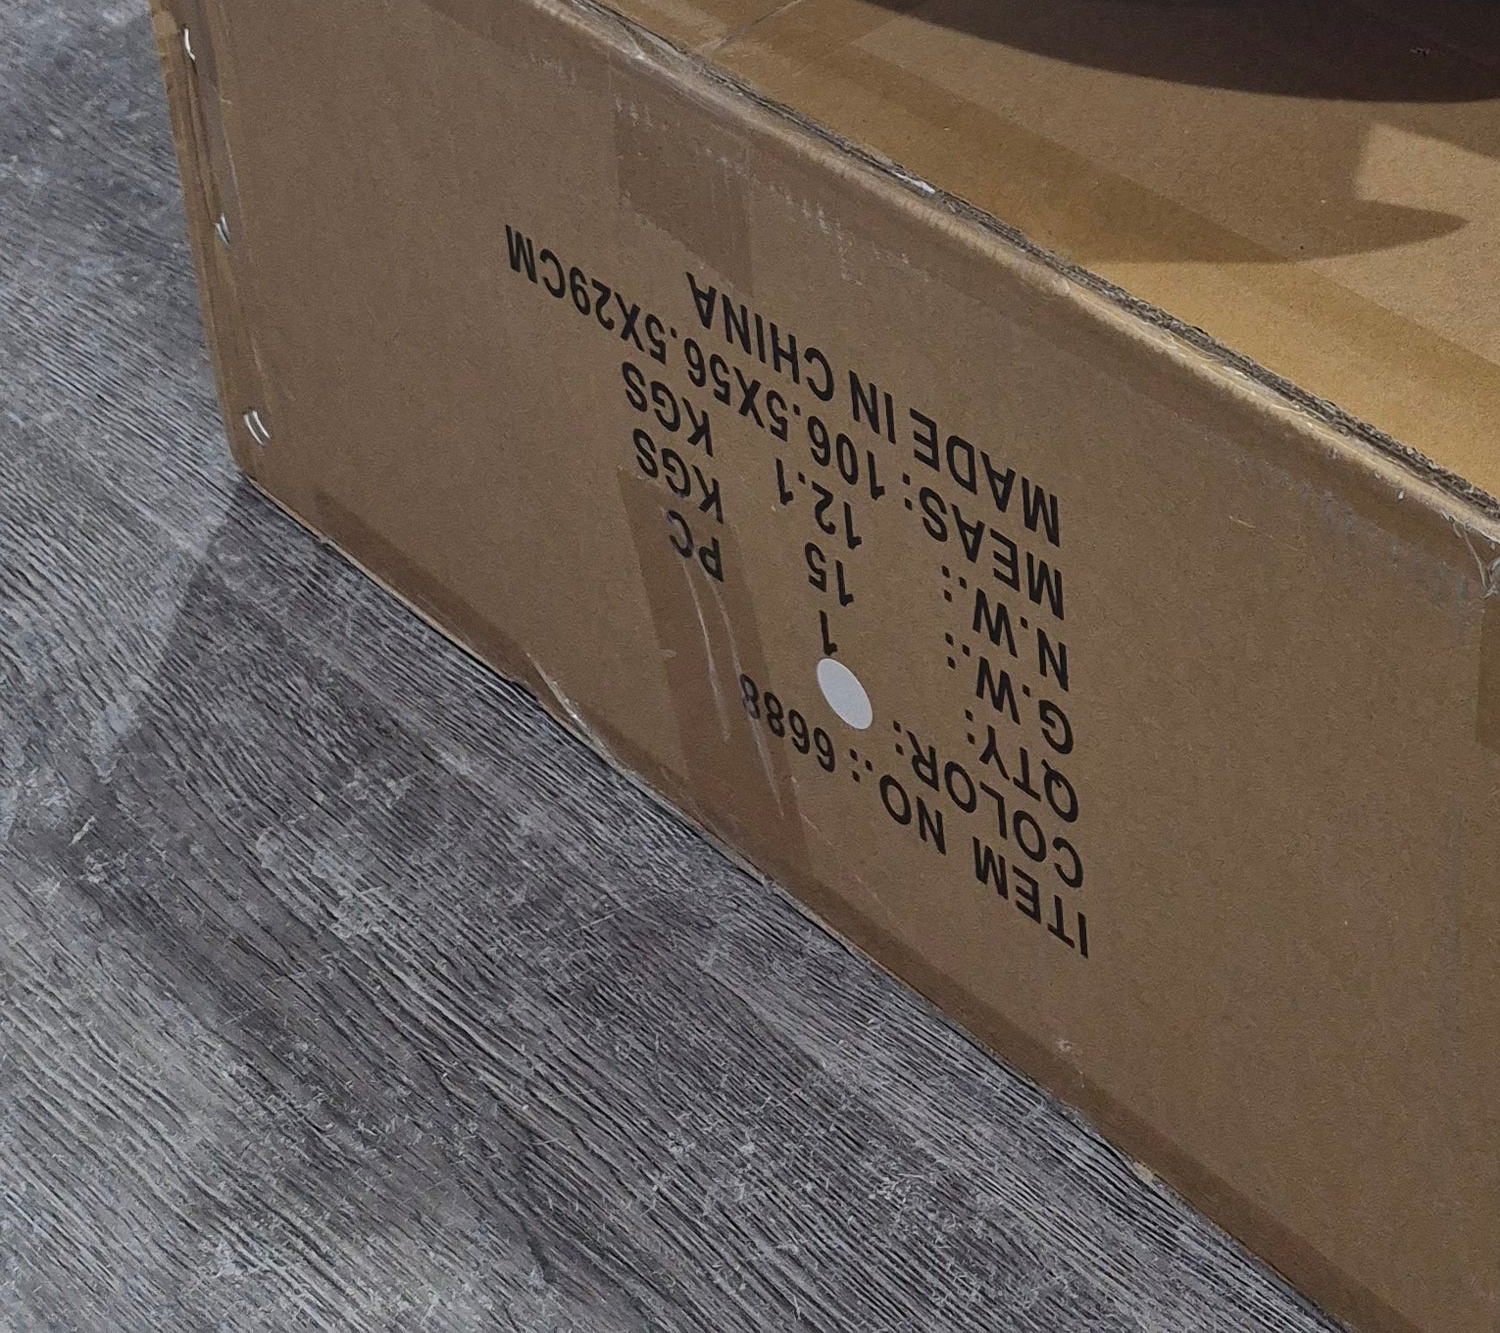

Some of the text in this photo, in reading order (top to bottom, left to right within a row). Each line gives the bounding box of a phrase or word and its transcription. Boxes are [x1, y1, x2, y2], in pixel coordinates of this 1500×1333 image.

[621, 361, 1070, 693] N.W.: 12.1 KGS
[685, 271, 1061, 548] MADE IN CHINA
[632, 427, 1074, 755] G.W.: 15 KGS
[667, 509, 1079, 823] QTY: 1 PC
[739, 673, 836, 774] 6688
[892, 720, 1084, 889] COLOR:
[971, 836, 1089, 960] ITEM
